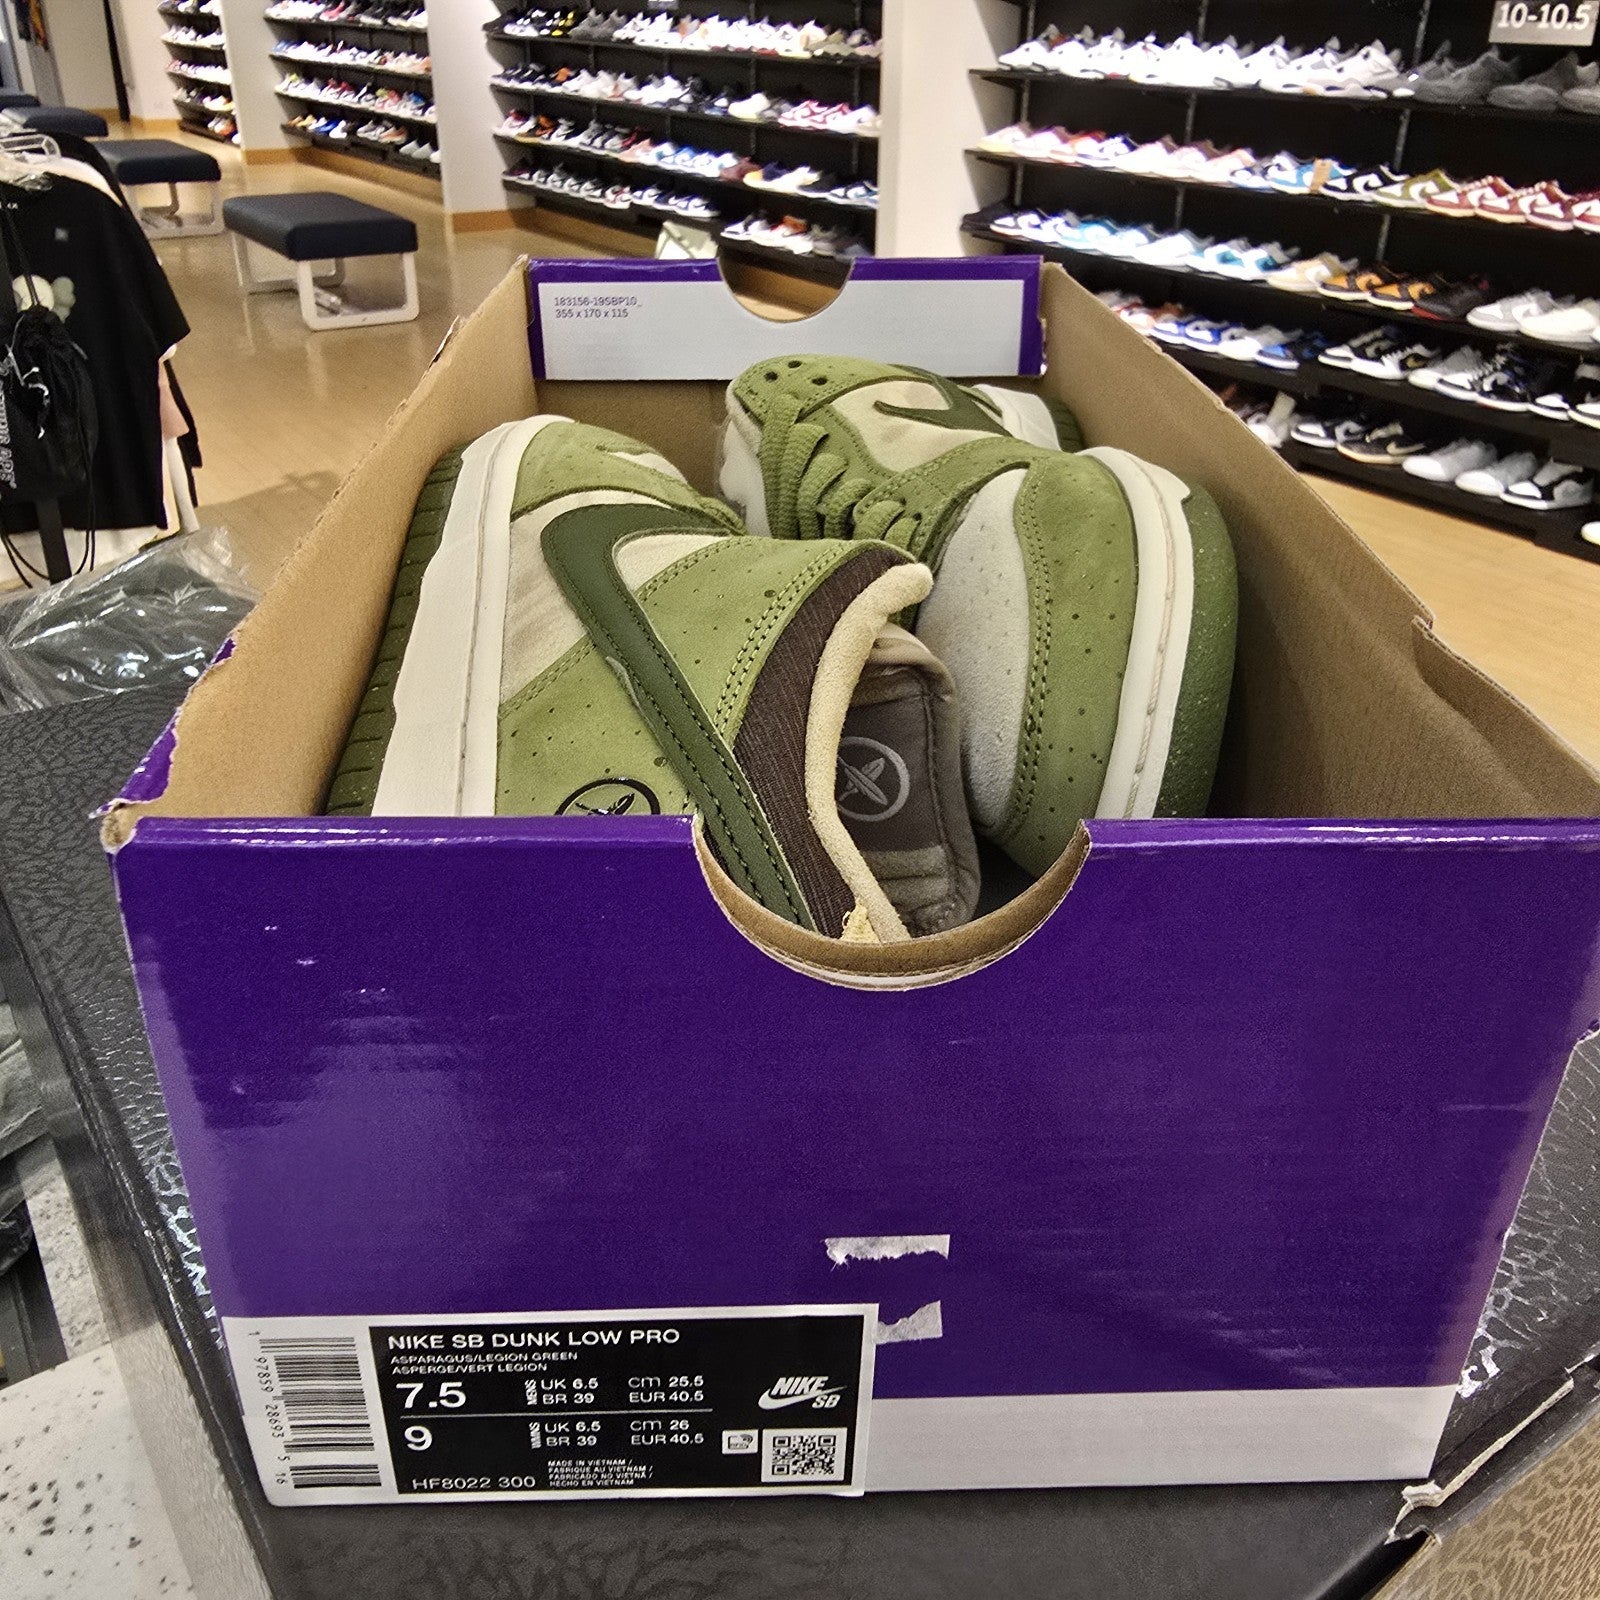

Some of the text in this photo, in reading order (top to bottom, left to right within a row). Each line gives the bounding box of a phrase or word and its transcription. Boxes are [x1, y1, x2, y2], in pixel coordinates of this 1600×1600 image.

[1497, 2, 1592, 30] 10-10.5
[556, 308, 629, 318] 355 x 170 x 115
[388, 1328, 680, 1350] NIKE SB DUNK LOW PRO
[390, 1351, 578, 1365] ASPARAGUS/LEGION GREEN
[392, 1362, 548, 1375] ASPERGE/VERT LEGION
[541, 1377, 599, 1390] UK 6.5
[628, 1375, 704, 1389] cm 25.5
[771, 1376, 829, 1396] NIKE
[254, 1357, 274, 1394] 97859
[265, 1404, 285, 1439] 28693
[395, 1381, 467, 1409] 7.5
[542, 1392, 595, 1405] BR 39
[629, 1390, 704, 1403] EUR 40.5
[811, 1394, 841, 1409] SB
[545, 1420, 601, 1433] UK 6.5
[630, 1419, 690, 1431] cm 26
[404, 1425, 433, 1451] 9
[546, 1435, 598, 1447] BR 39
[630, 1432, 704, 1446] EUR 40.5
[575, 1459, 585, 1467] IN
[412, 1476, 536, 1490] HF8022 300
[582, 1479, 594, 1487] EN
